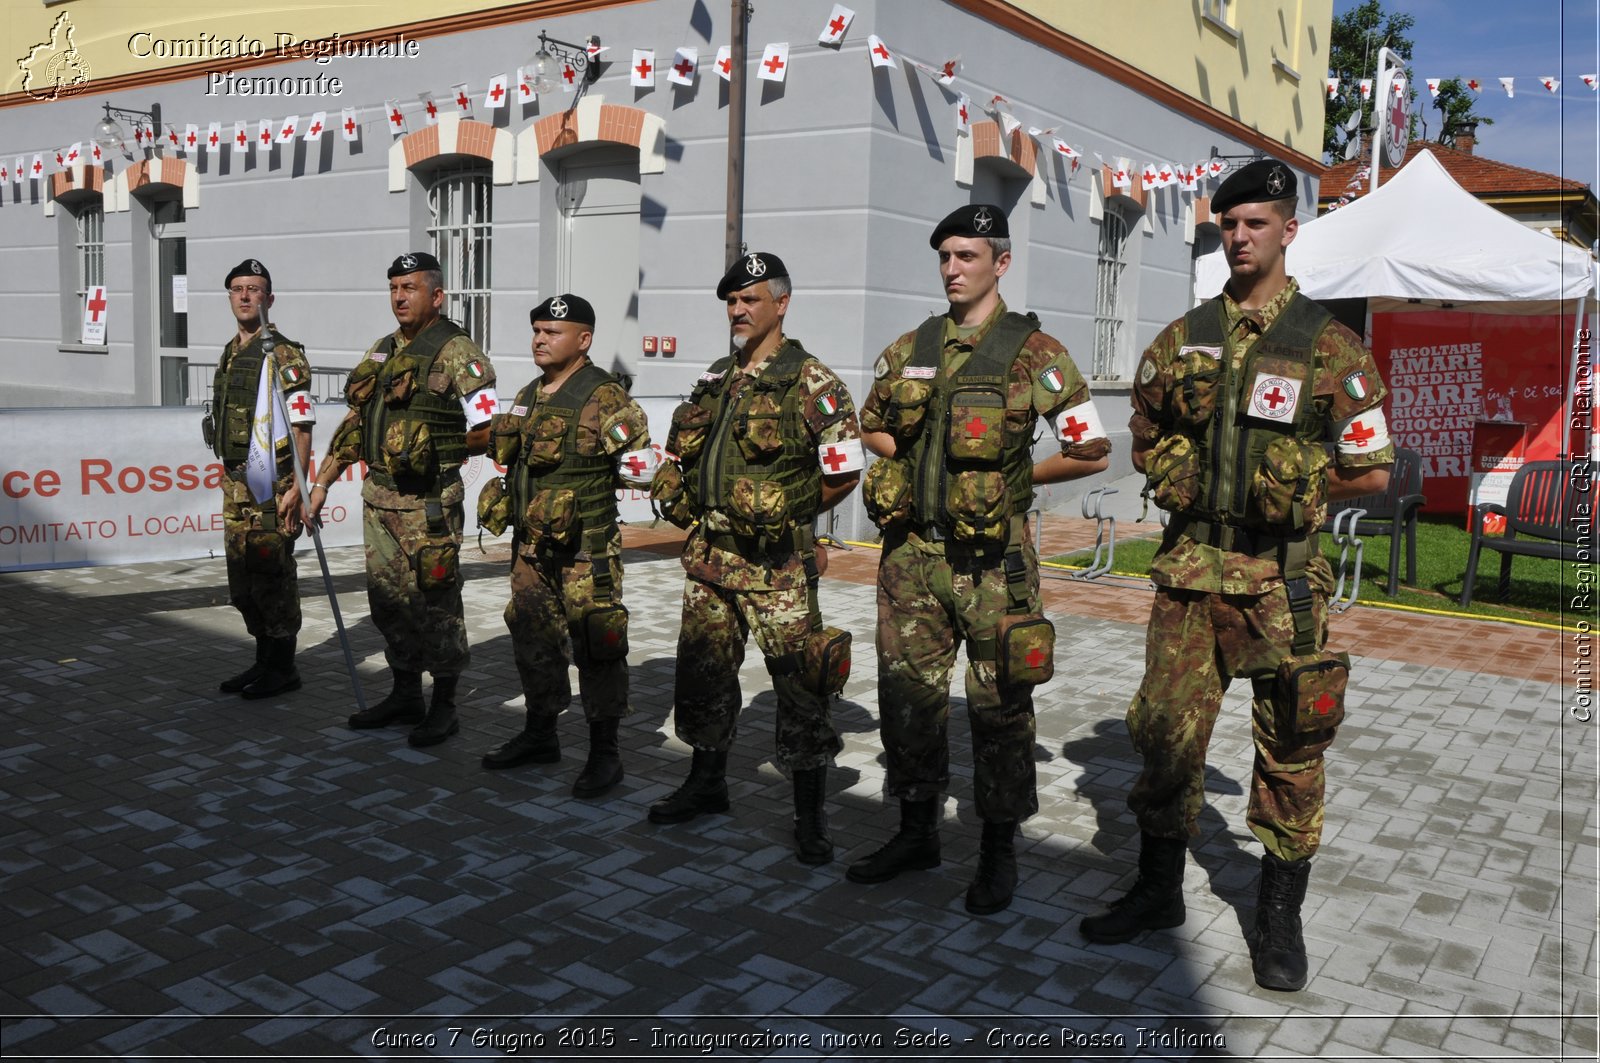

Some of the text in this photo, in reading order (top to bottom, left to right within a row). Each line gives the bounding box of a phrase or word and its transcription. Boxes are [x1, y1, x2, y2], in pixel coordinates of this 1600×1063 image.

[1389, 343, 1482, 360] ASCOLTARE
[1390, 353, 1482, 375] AMARE
[1390, 370, 1482, 387] CREDERE
[1391, 383, 1483, 408] DARE
[1391, 403, 1481, 419] RICEVERE
[1391, 430, 1474, 448] VOLAR
[80, 458, 225, 496] Rossa
[128, 513, 225, 536] LOCALE
